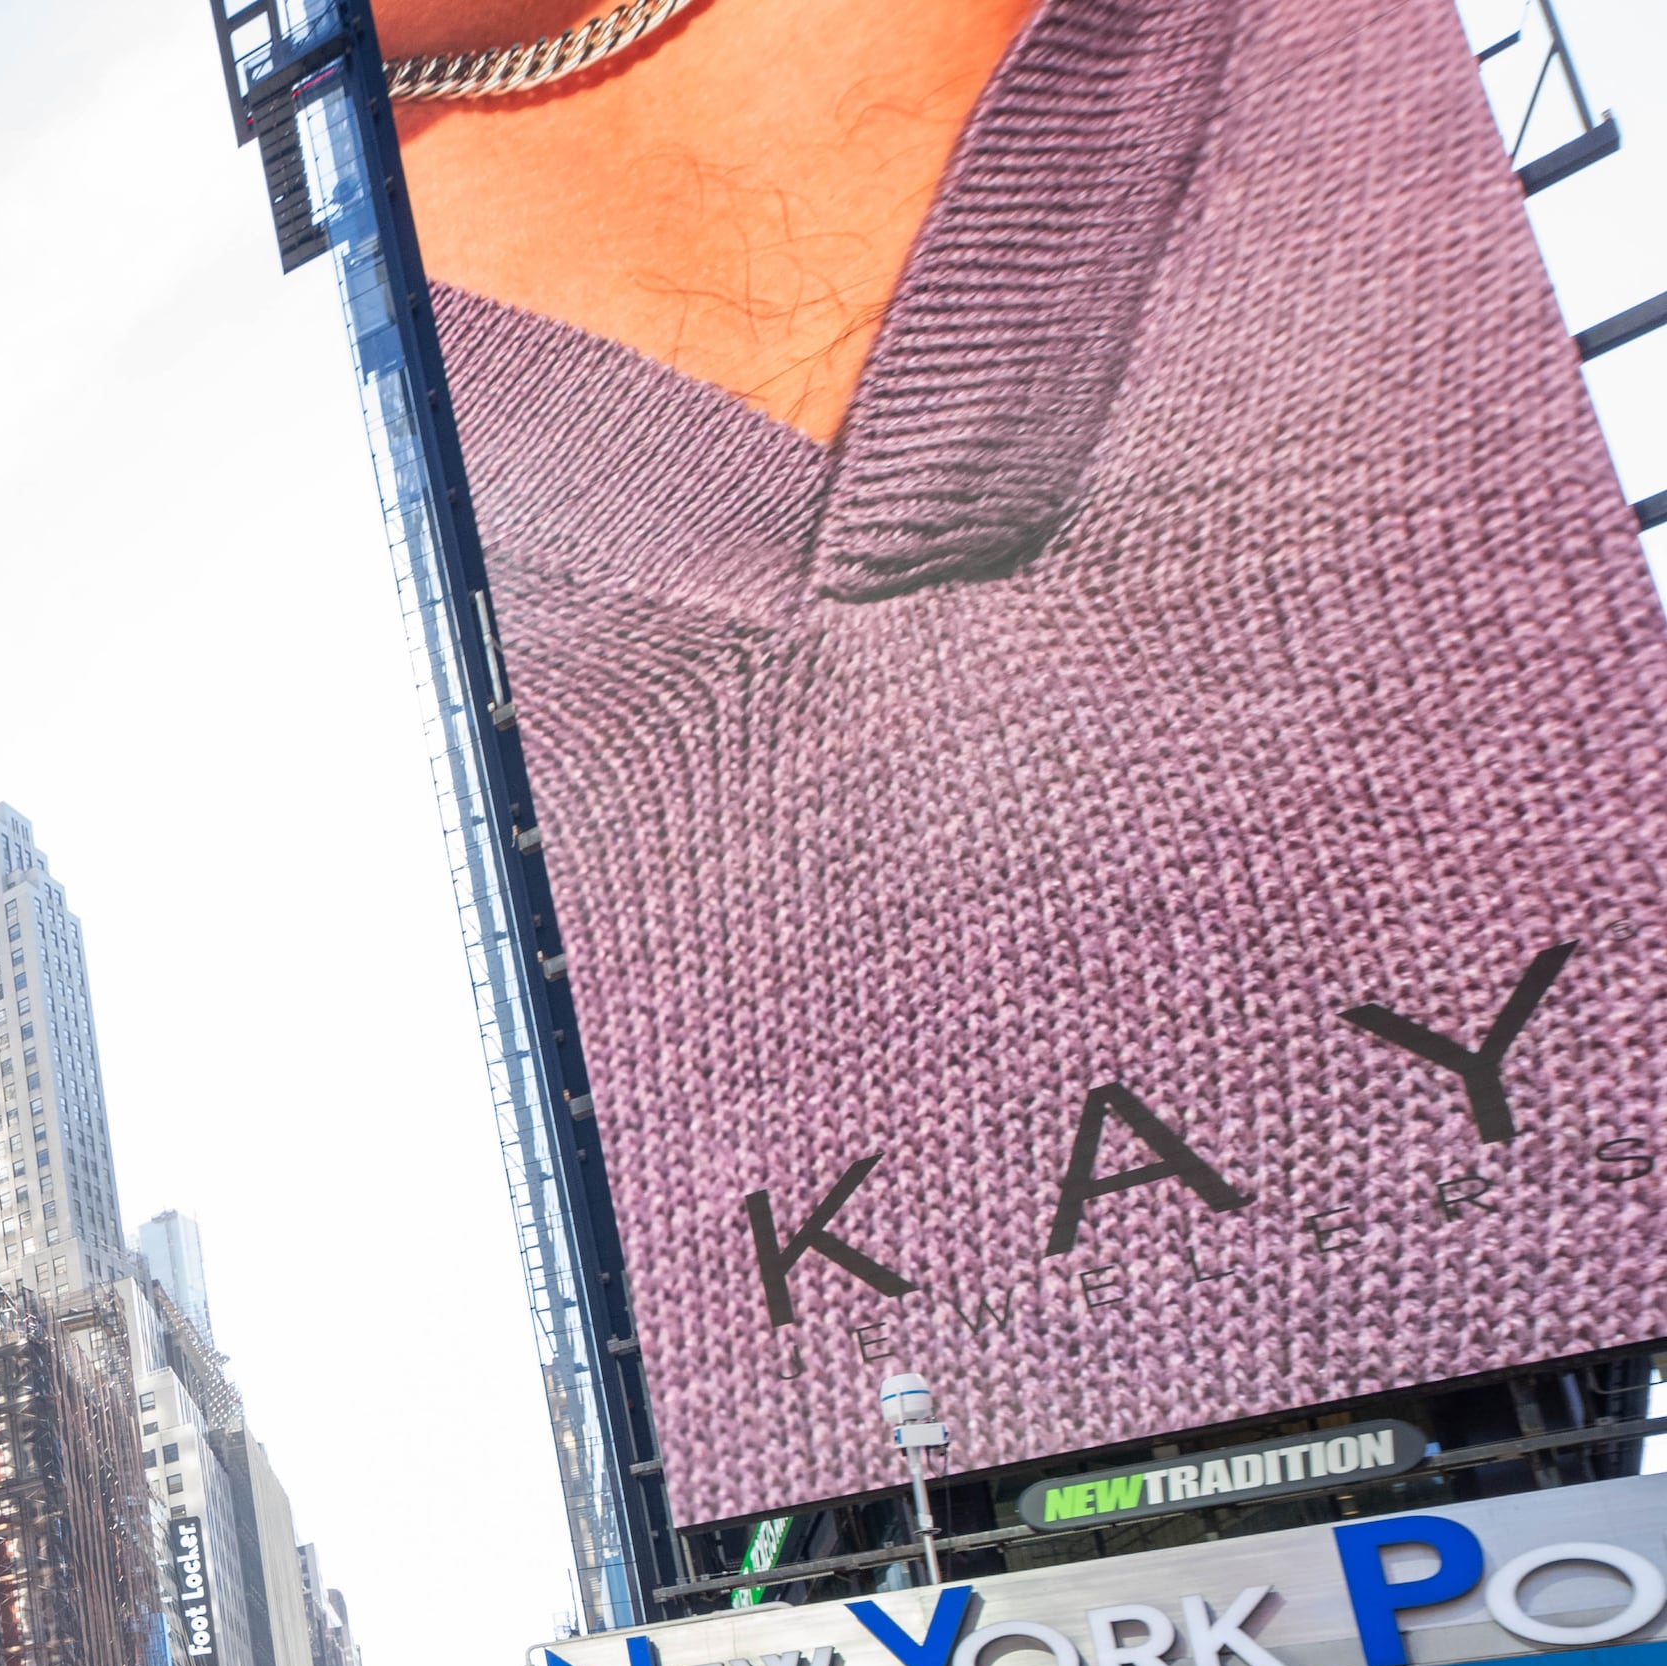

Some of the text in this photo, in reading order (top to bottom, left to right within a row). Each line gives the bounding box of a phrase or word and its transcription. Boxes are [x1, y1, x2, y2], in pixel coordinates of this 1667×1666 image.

[745, 938, 1579, 1328] KAY
[775, 1137, 1653, 1380] JEWELERS
[185, 1604, 212, 1656] Foot
